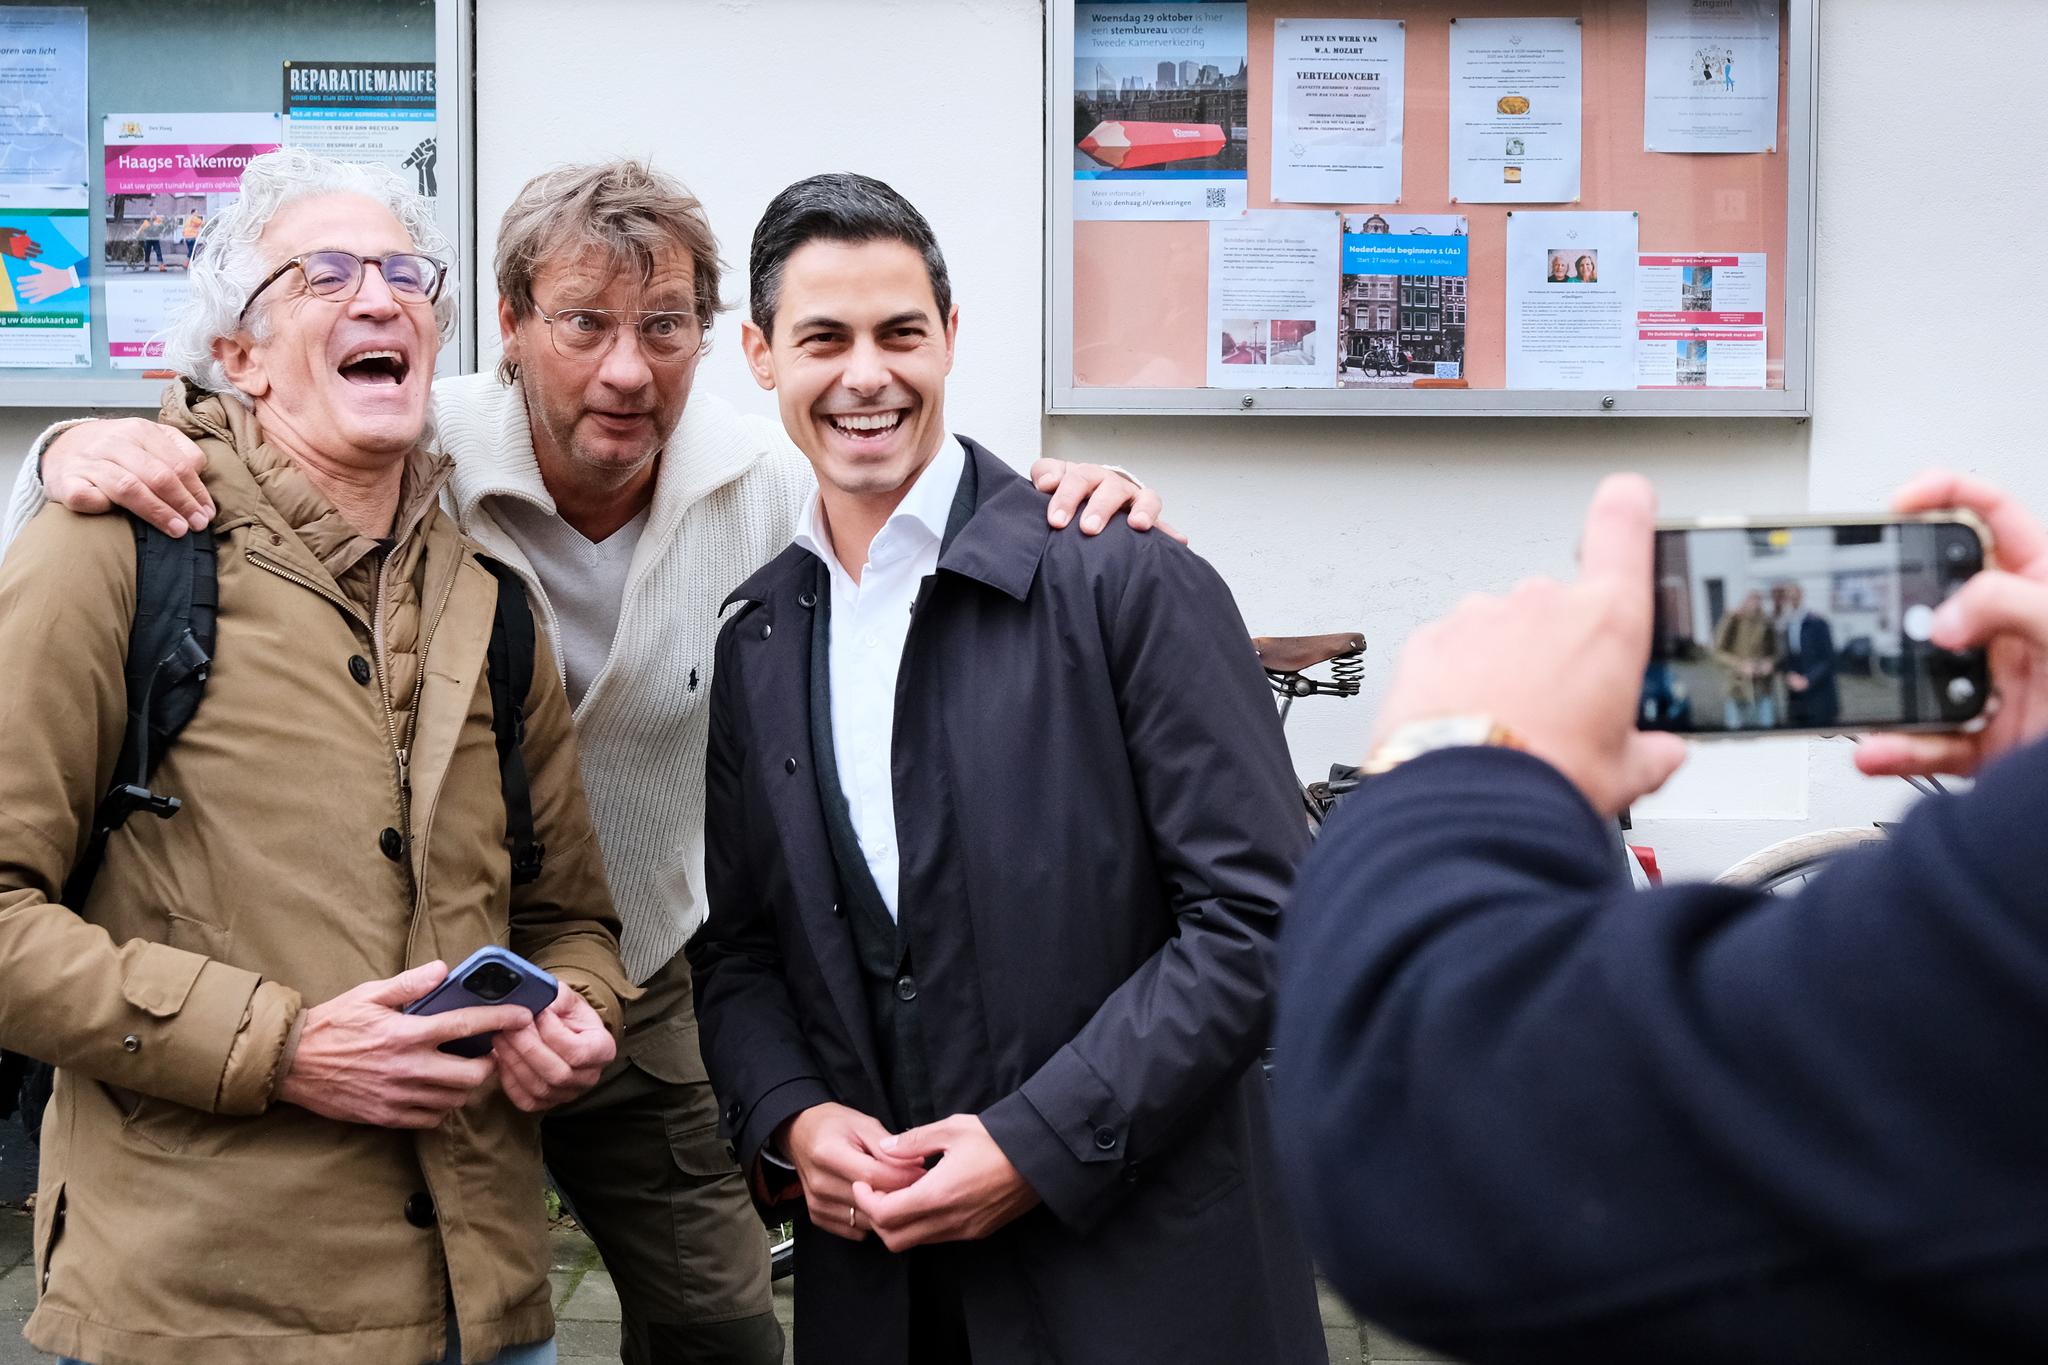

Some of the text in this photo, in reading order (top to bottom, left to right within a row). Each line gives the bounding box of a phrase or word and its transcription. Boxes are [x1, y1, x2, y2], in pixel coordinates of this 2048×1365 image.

[1091, 12, 1223, 24] Woensdag 29 oktober is hier
[1091, 27, 1108, 35] een
[1110, 26, 1168, 34] stembureau
[1192, 25, 1203, 34] de
[1092, 38, 1205, 49] Tweede Kamerverkiezing
[38, 47, 57, 56] licht
[290, 69, 434, 92] REPARATIEMANIFE
[1296, 72, 1381, 81] VERTELCONCERT
[118, 155, 173, 172] Haagse
[120, 182, 134, 190] Laat
[146, 183, 164, 191] groot
[165, 182, 194, 190] tuinafval
[195, 182, 213, 191] gratis
[215, 182, 241, 192] ophale
[1113, 199, 1192, 207] denhaag.nl/verkiezingen
[1349, 246, 1396, 254] Nederlands
[1397, 247, 1437, 256] beginners
[1444, 247, 1461, 255] (A1)
[20, 316, 65, 324] cadeaukaart
